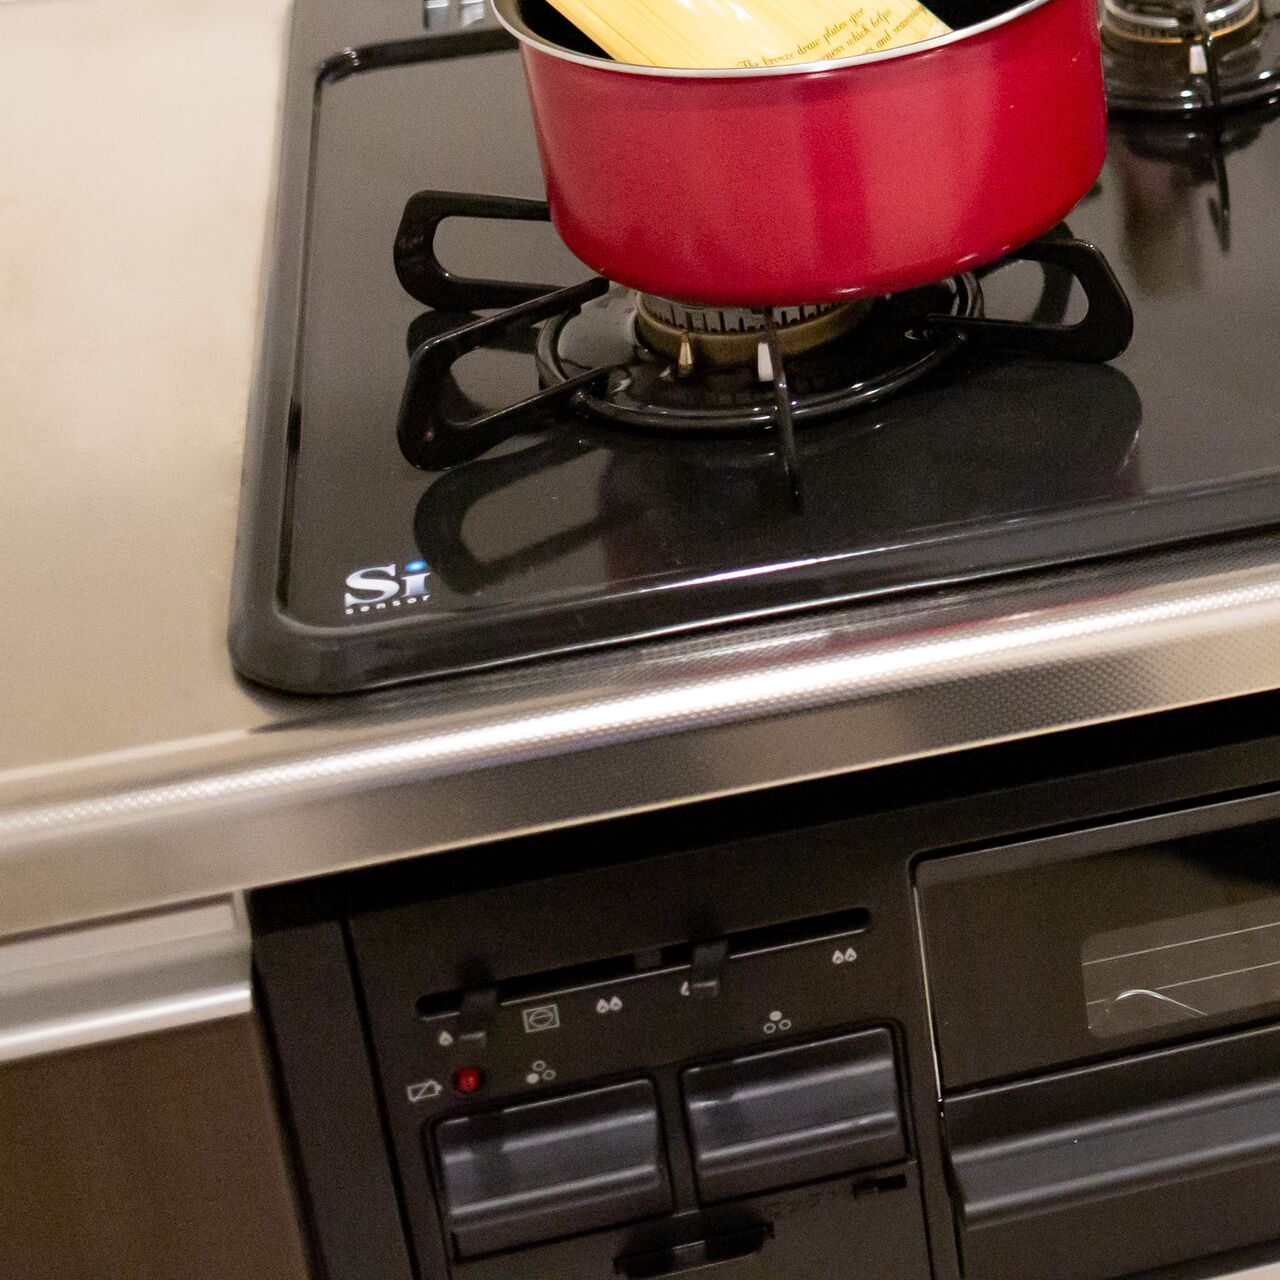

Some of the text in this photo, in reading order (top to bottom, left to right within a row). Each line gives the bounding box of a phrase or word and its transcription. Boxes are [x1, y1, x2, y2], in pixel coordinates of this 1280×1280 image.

[822, 21, 848, 46] plates
[848, 7, 865, 27] give
[846, 24, 871, 47] which
[869, 9, 892, 30] helps
[875, 29, 893, 49] and
[344, 561, 431, 608] Si
